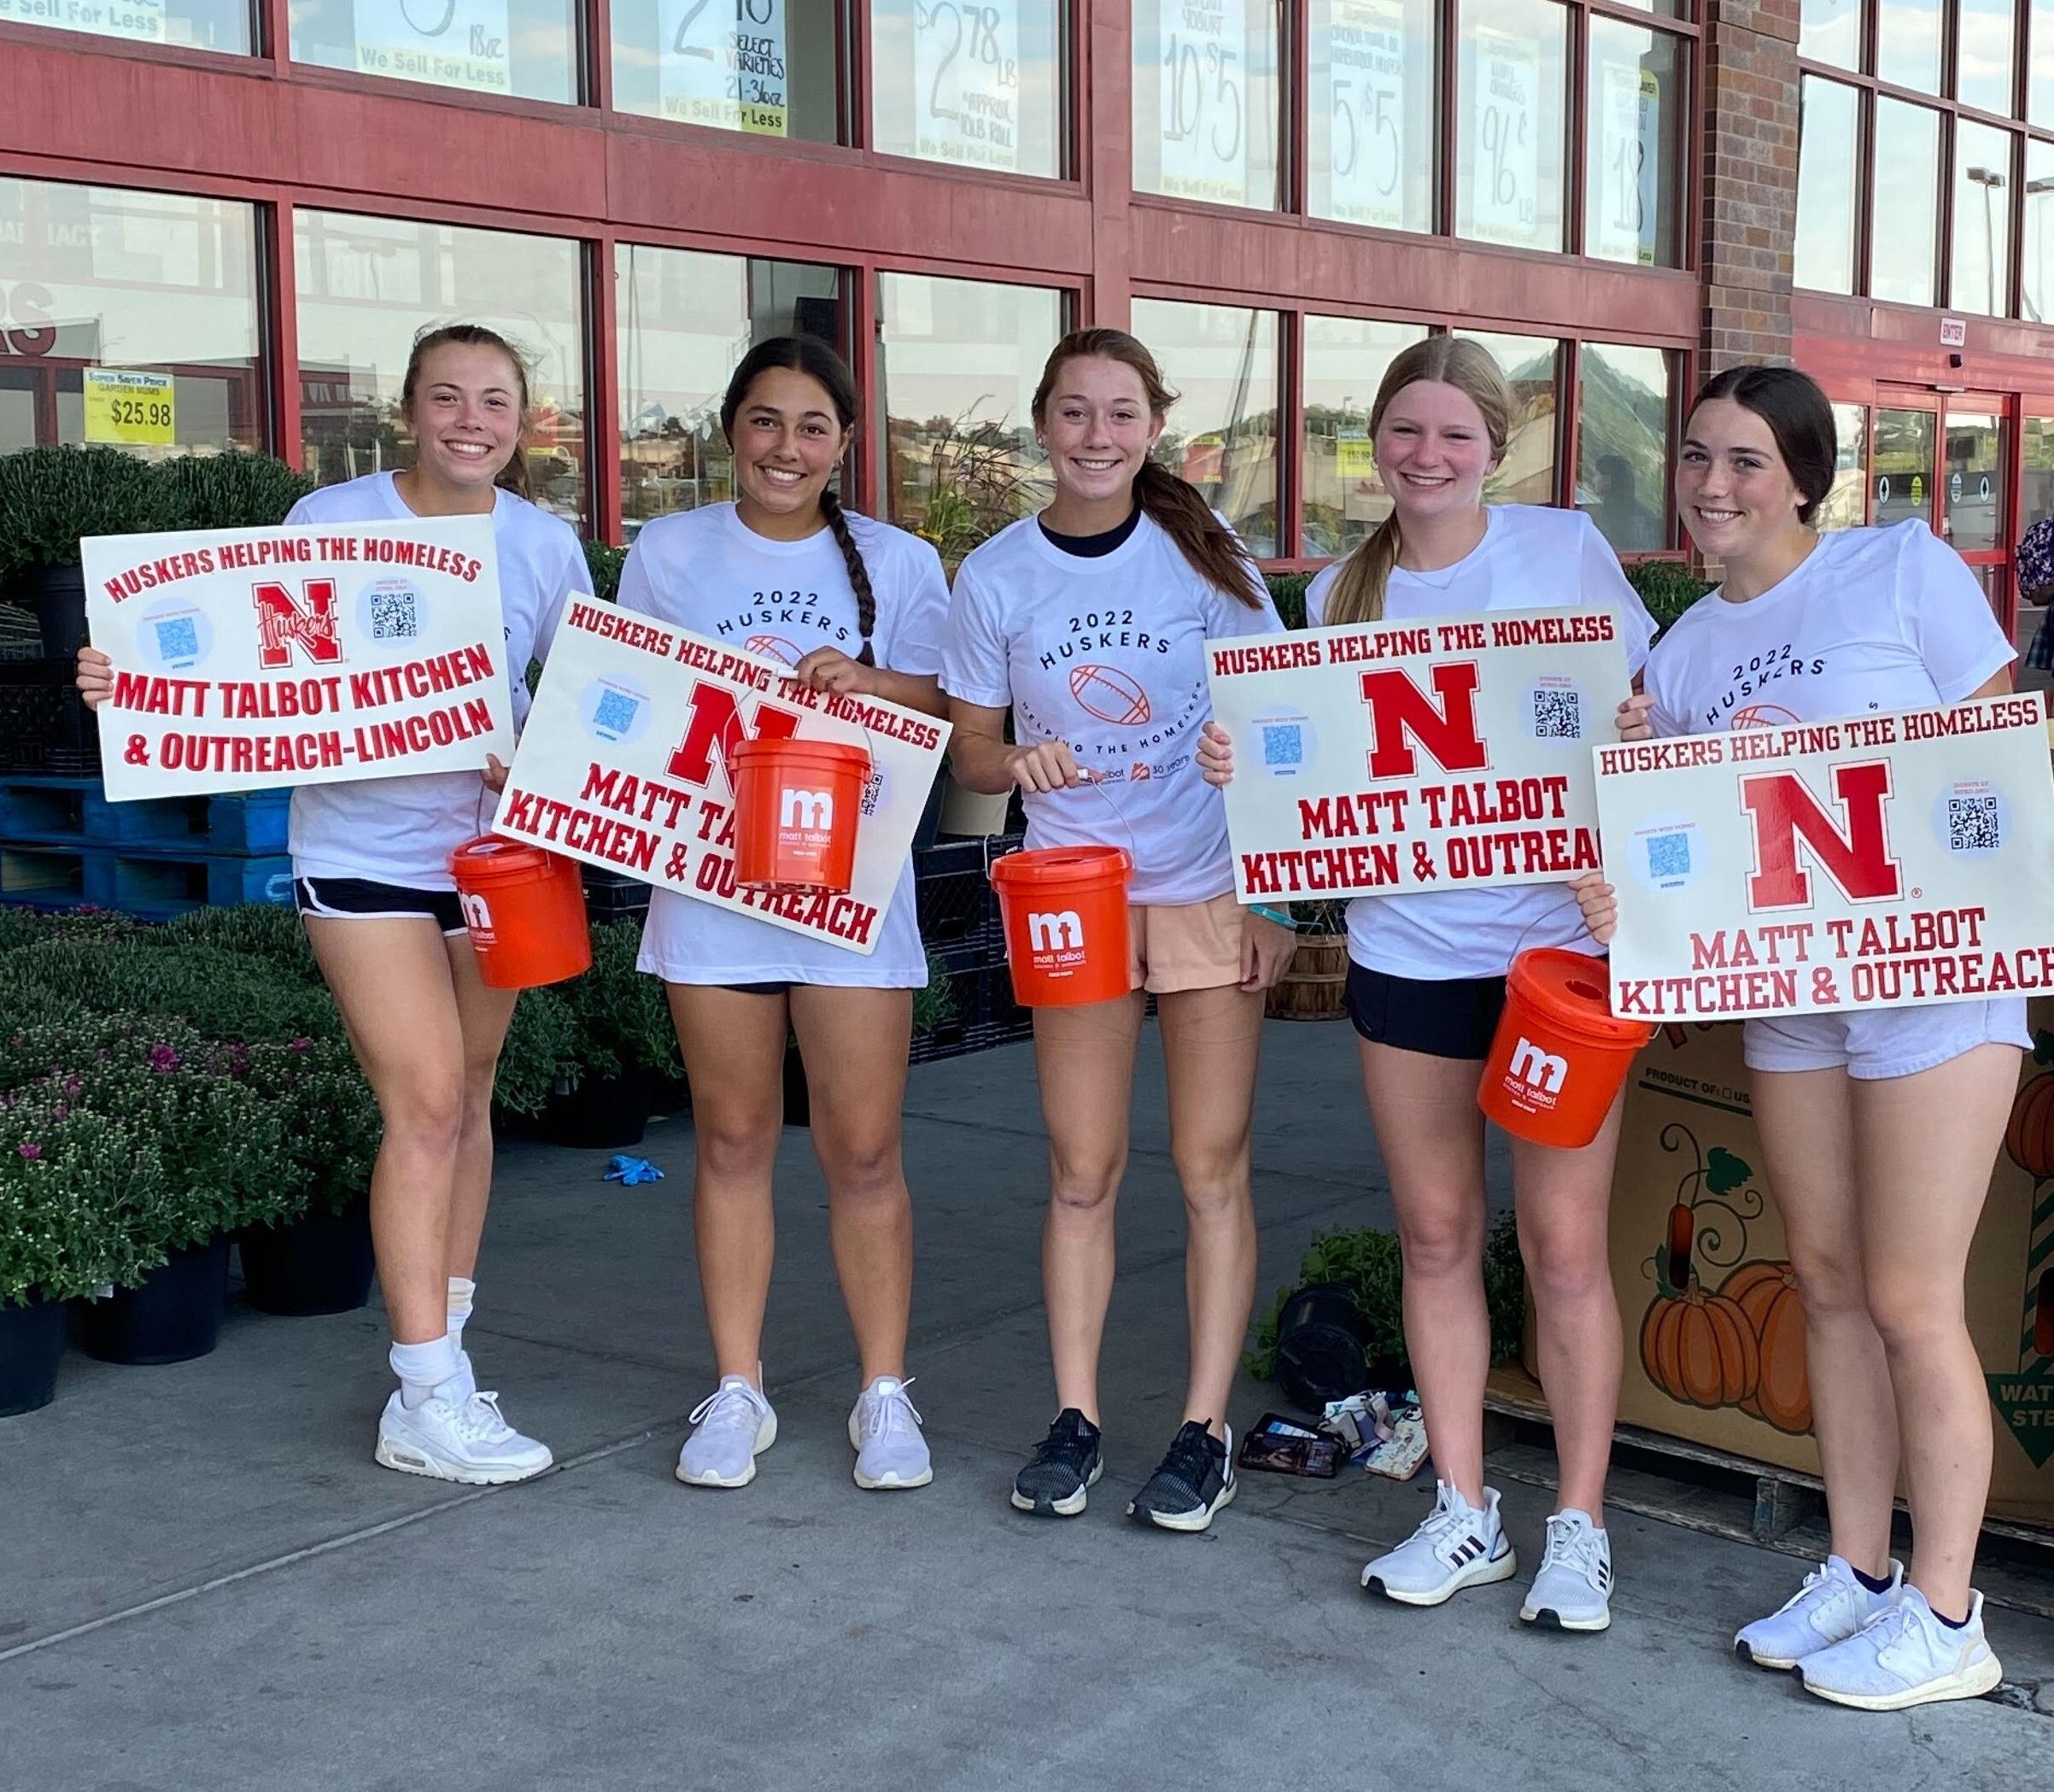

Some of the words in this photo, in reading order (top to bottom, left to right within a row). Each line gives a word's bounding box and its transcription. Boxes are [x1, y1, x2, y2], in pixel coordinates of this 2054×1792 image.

[67, 2, 102, 24] For
[109, 7, 159, 32] Less
[361, 47, 389, 67] We
[394, 52, 427, 74] Sell
[434, 58, 461, 79] For
[466, 61, 505, 85] Less
[726, 50, 785, 80] VARIETIES
[729, 32, 775, 58] SELECT
[998, 56, 1016, 89] LB
[664, 96, 688, 116] We
[692, 101, 719, 121] Sell
[723, 106, 746, 123] For
[752, 109, 782, 128] Less
[1943, 323, 1963, 341] ENTER
[111, 399, 171, 427] $25.98
[103, 547, 215, 605] HUSKERS
[217, 538, 312, 571] HELPING
[316, 537, 358, 561] THE
[363, 538, 483, 583] HOMELESS
[752, 590, 818, 607] 2022
[1068, 609, 1133, 633] 2022
[251, 577, 342, 670] N
[257, 601, 339, 650] Huskers
[717, 609, 851, 641] HUSKERS
[1213, 641, 1322, 676] HUSKERS
[1327, 626, 1432, 665] HELPING
[1437, 622, 1487, 651] THE
[1490, 615, 1614, 647] HOMELESS
[1039, 631, 1172, 671] HUSKERS
[1733, 644, 1792, 682] 2022
[114, 671, 212, 718] MATT
[217, 676, 342, 719] TALBOT
[348, 642, 494, 710] KITCHEN
[567, 602, 674, 658] HUSKERS
[675, 637, 774, 692] HELPING
[826, 693, 941, 752] HOMELESS
[123, 733, 150, 766] &
[159, 697, 494, 773] OUTREACH-LINCOLN
[1358, 659, 1491, 782] N
[1600, 739, 1723, 776] HUSKERS
[1730, 725, 1840, 763] HELPING
[1844, 717, 1897, 749] THE
[1901, 698, 2040, 741] HOMELESS
[1096, 744, 1127, 753] THE
[579, 762, 691, 829] MATT
[1297, 790, 1409, 840] MATT
[1420, 776, 1568, 829] TALBOT
[502, 788, 662, 874] KITCHEN
[664, 842, 688, 883] &
[1737, 757, 1905, 915] N
[1241, 844, 1400, 894] KITCHEN
[1412, 840, 1437, 882] &
[1446, 828, 1601, 879] OUTREA
[1689, 922, 1814, 971] MATT
[1827, 907, 1986, 957] TALBOT
[1618, 969, 1798, 1016] KITCHEN
[1812, 967, 1840, 1005] &
[1852, 946, 2054, 1002] OUTREACH
[1645, 1067, 1699, 1091] PRODUCT
